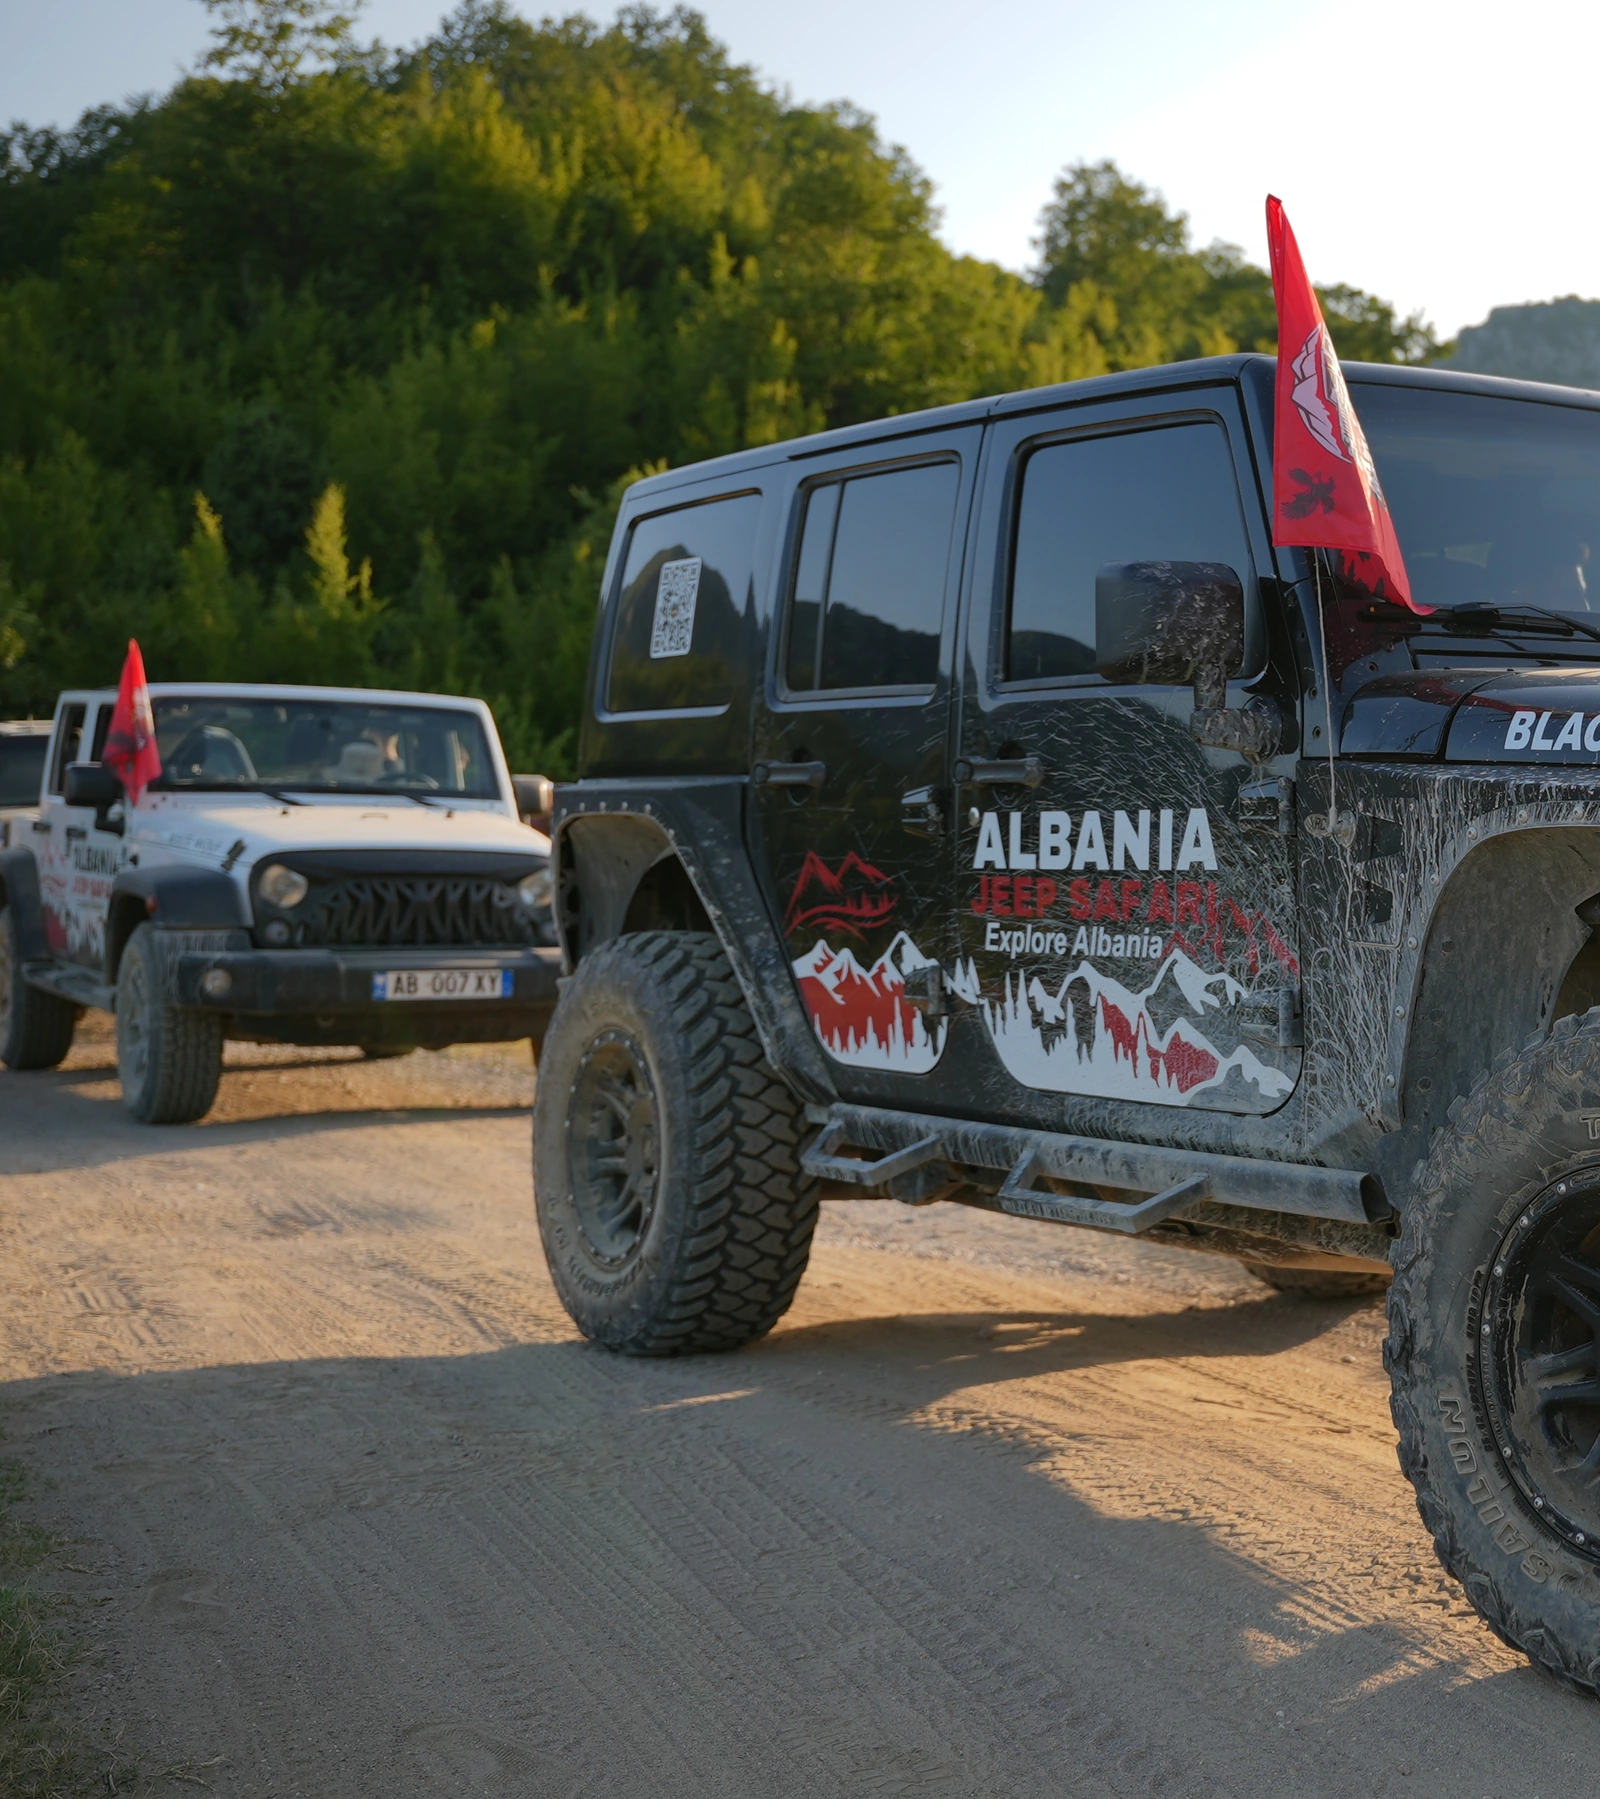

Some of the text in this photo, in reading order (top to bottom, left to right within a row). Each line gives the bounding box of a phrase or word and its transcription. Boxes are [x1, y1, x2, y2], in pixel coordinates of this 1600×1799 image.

[972, 808, 1218, 871] ALBANIA
[970, 875, 1217, 925] JEEP SAFARI
[984, 922, 1163, 959] Explore Albania
[393, 972, 499, 994] AB 007 XY
[1438, 1396, 1555, 1585] SAILUN
